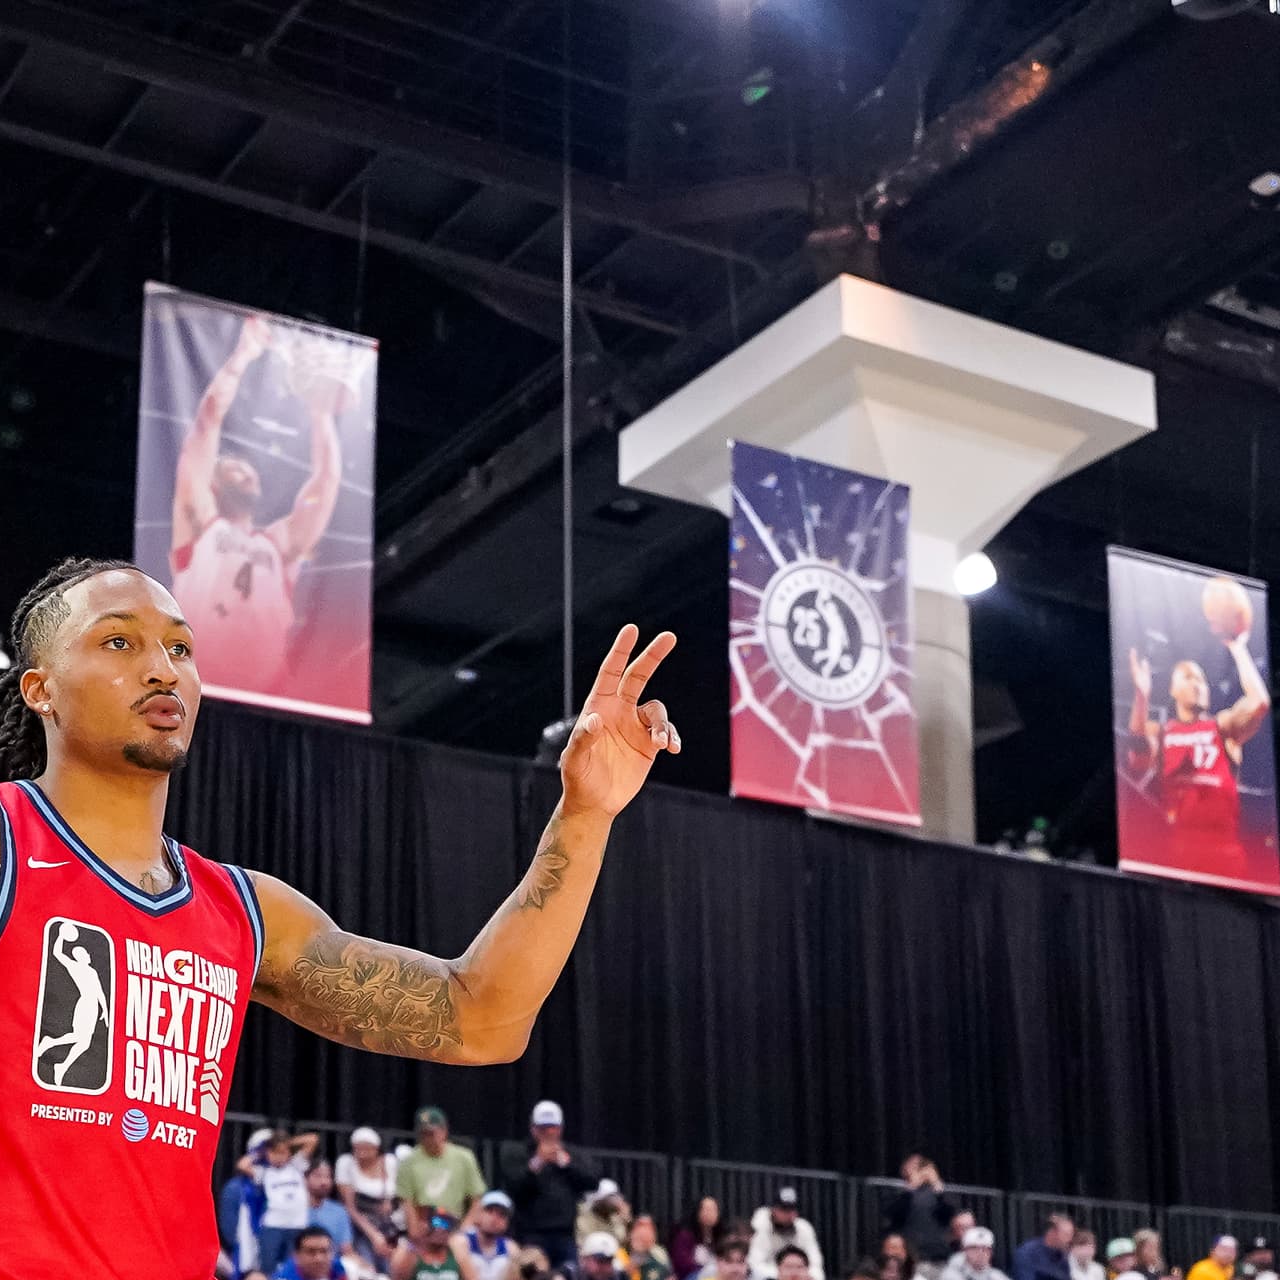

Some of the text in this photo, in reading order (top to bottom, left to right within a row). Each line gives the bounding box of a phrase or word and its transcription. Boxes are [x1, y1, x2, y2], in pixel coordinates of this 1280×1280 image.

[125, 937, 166, 981] NBA
[193, 953, 239, 1005] LEAGUE
[125, 973, 235, 1064] NEXT UP
[124, 1039, 200, 1115] GAME
[31, 1103, 197, 1150] PRESENTED BY AT&T
